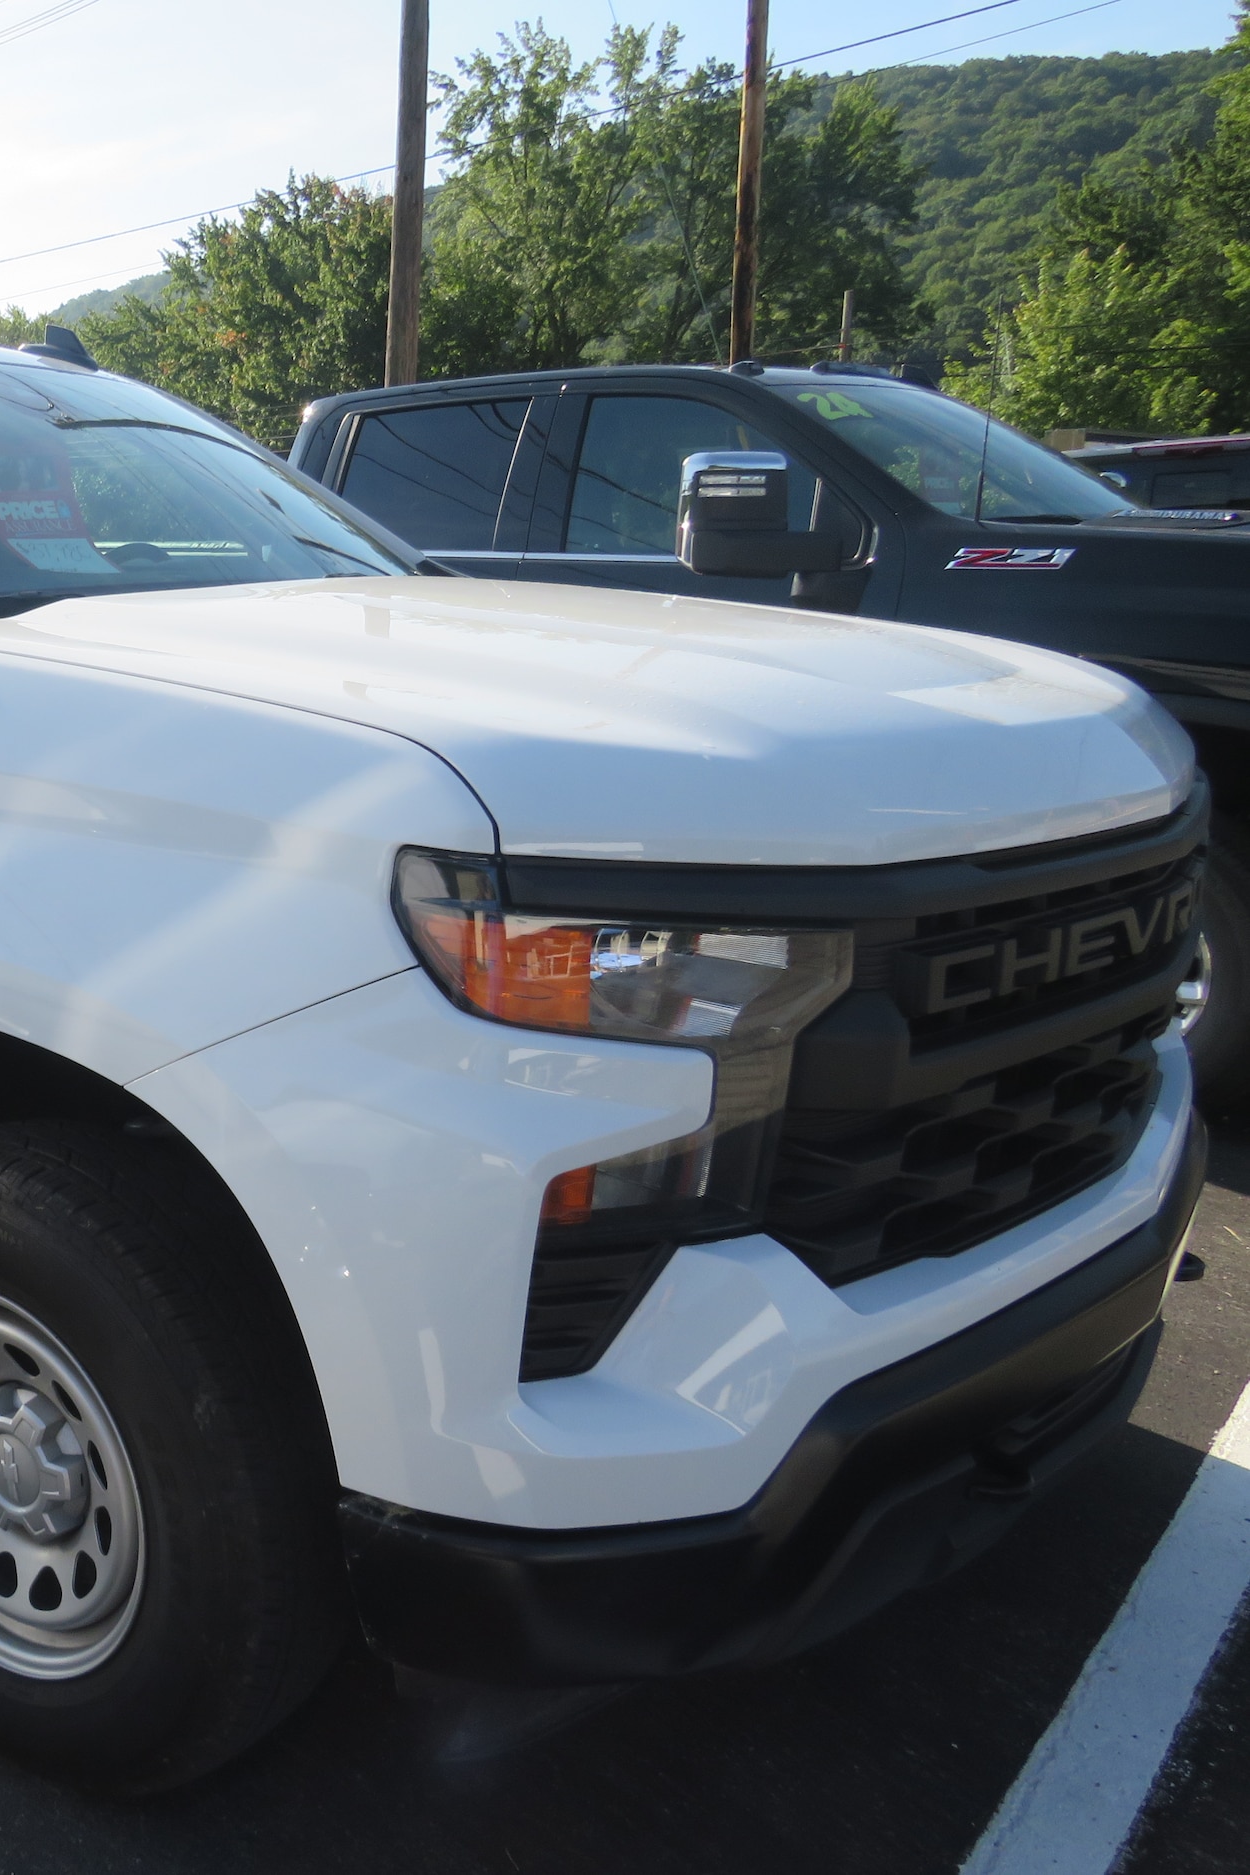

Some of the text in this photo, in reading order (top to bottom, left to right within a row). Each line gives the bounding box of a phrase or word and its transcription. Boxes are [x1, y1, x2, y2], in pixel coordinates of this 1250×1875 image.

[796, 391, 875, 422] 24
[5, 519, 78, 533] ASSURANCE
[942, 547, 1078, 571] Z71
